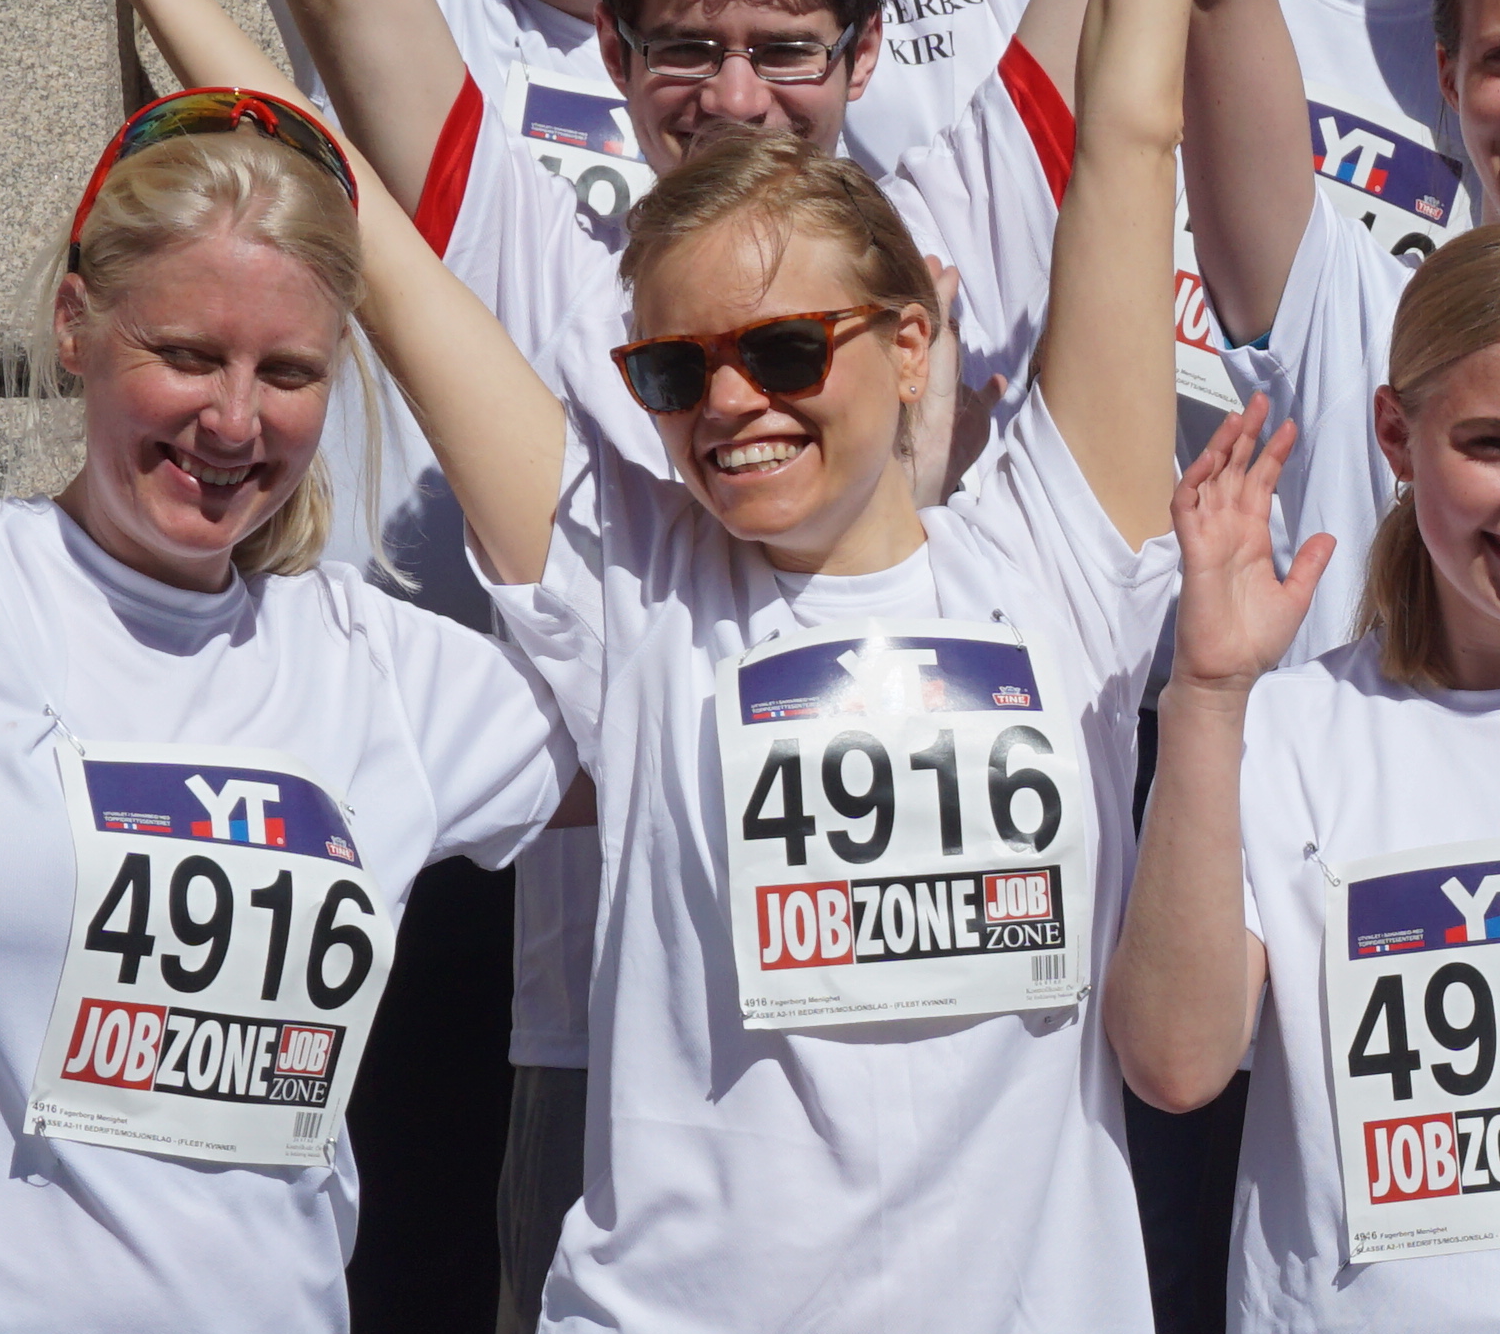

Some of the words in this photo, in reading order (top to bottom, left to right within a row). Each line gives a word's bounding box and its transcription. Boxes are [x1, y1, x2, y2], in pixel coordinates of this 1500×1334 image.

[1318, 116, 1395, 189] YT
[996, 694, 1027, 705] TINE
[184, 773, 281, 845] YT
[742, 725, 1062, 866] 4916
[329, 844, 352, 860] TINE
[987, 875, 1049, 918] JOB
[84, 852, 376, 1010] 4916
[986, 922, 1061, 949] ZONE
[743, 997, 767, 1007] 4916
[279, 1029, 331, 1073] JOB
[32, 1101, 57, 1113] 4916
[269, 1077, 329, 1103] ZONE
